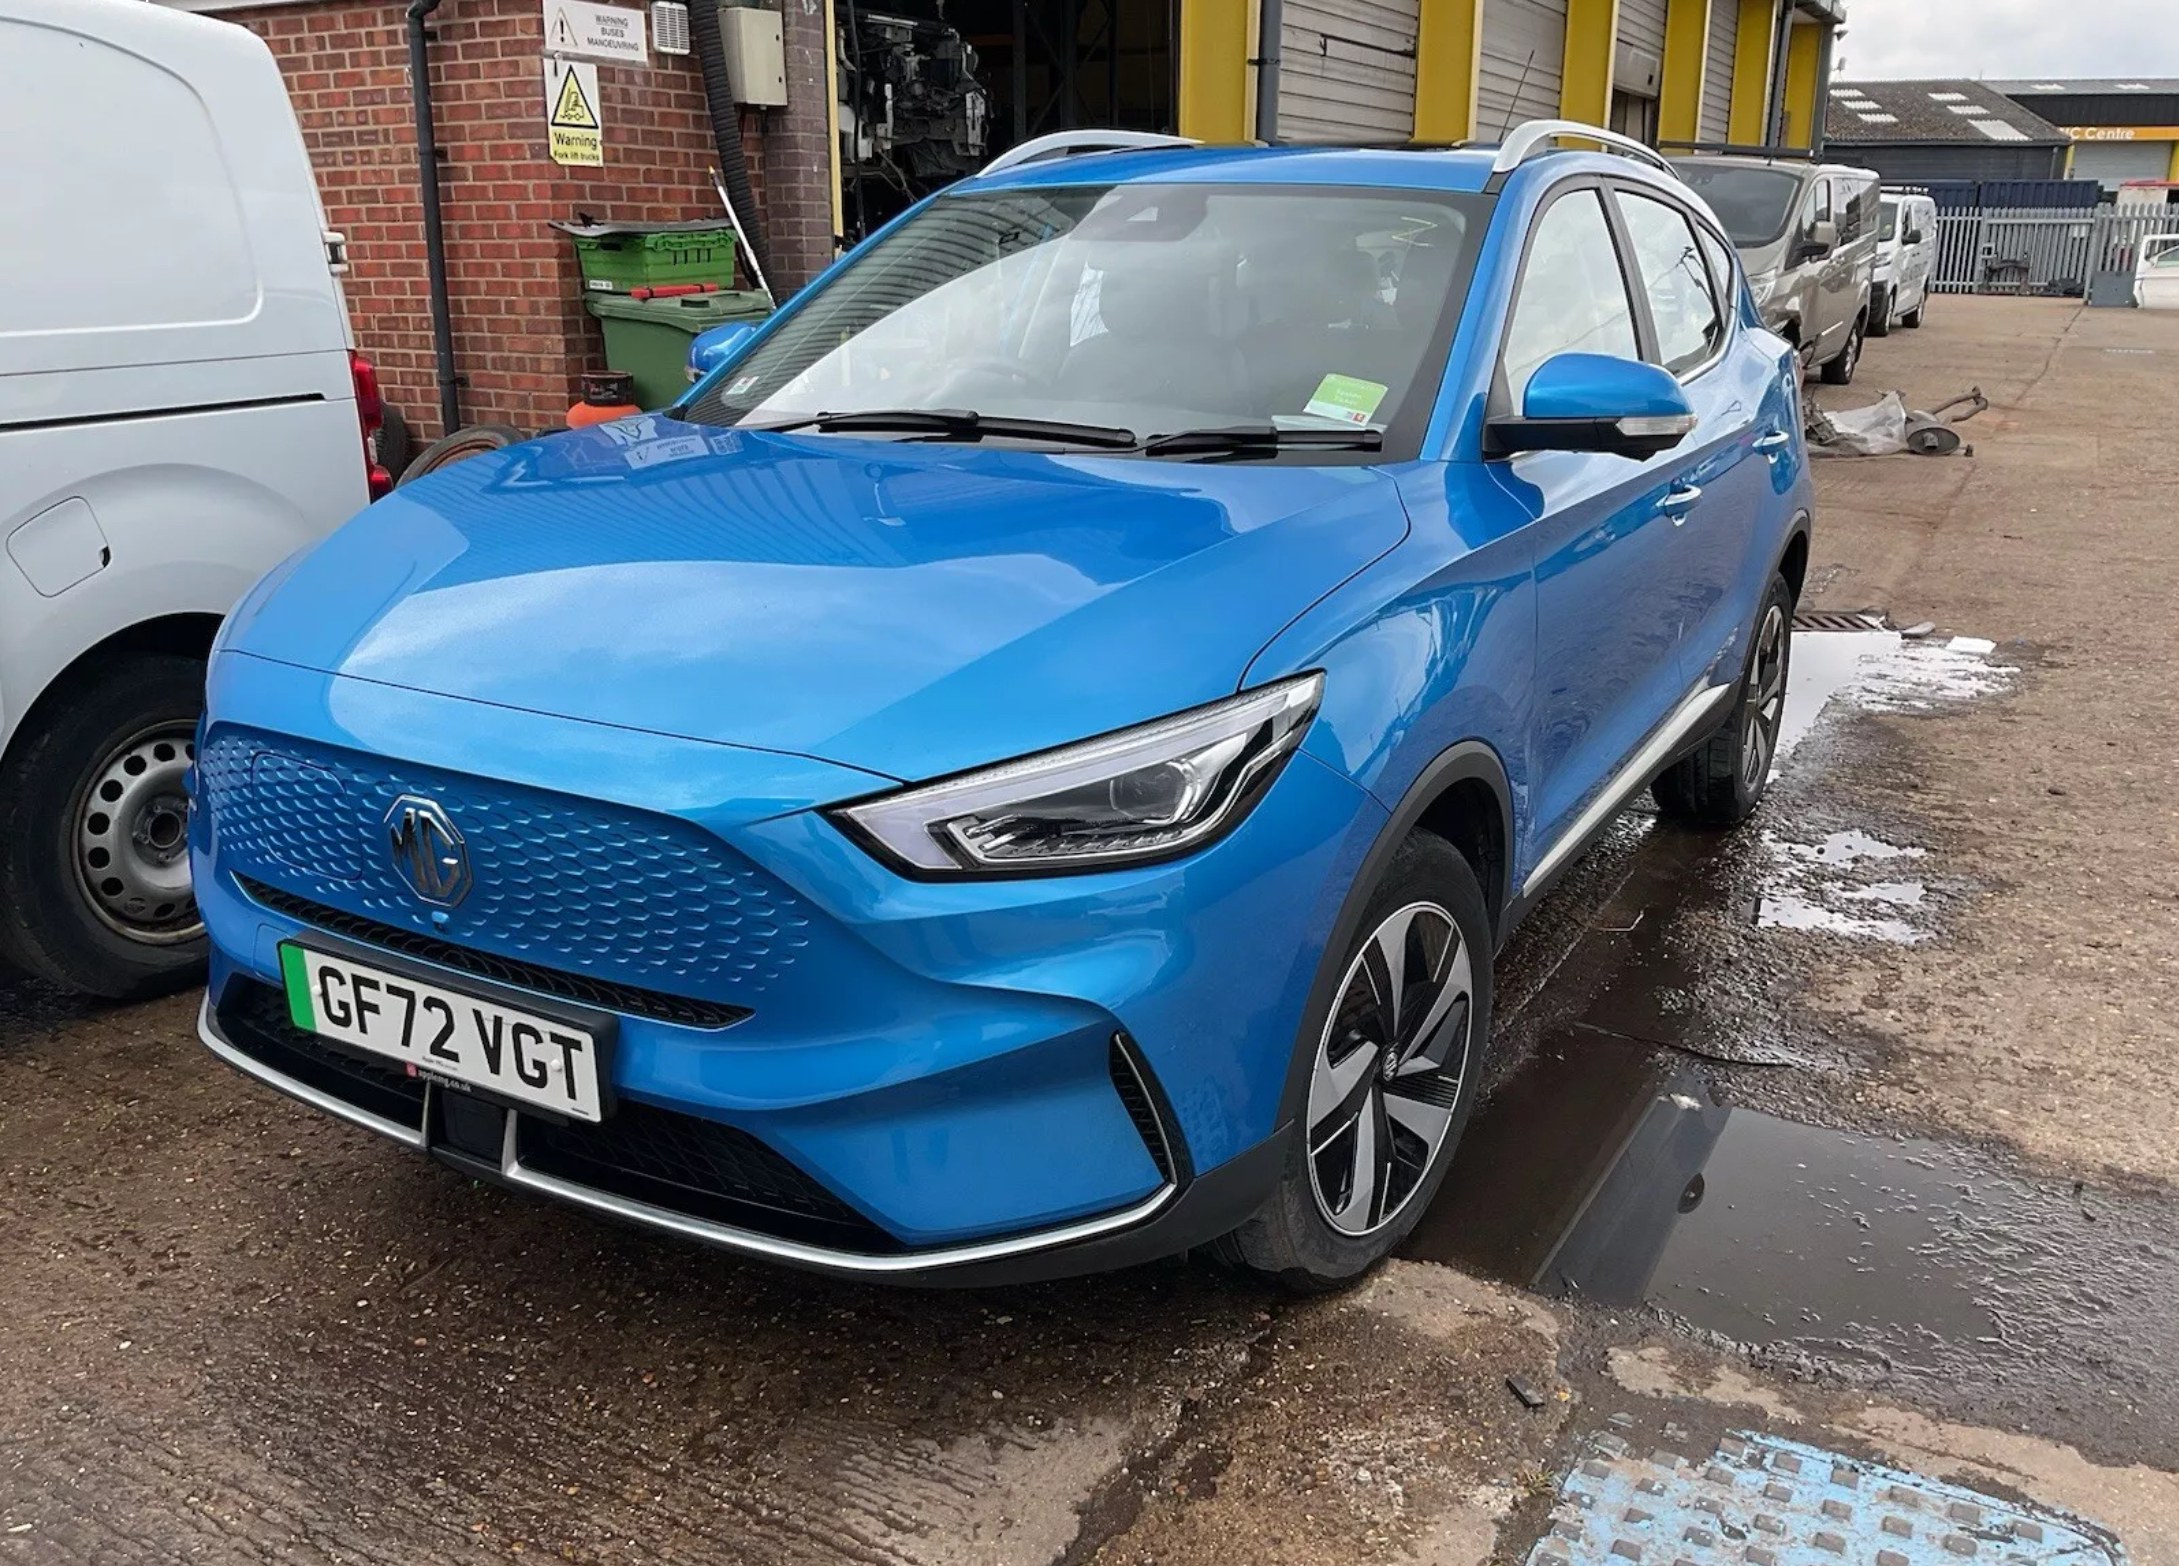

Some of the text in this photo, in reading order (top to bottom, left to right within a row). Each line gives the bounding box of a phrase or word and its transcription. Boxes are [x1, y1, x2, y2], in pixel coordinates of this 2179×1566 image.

[595, 15, 628, 27] WARNING
[600, 27, 625, 38] BUSES
[587, 37, 639, 51] MANOEUVRING
[2085, 126, 2136, 140] Centre
[554, 132, 598, 151] Warning
[389, 806, 460, 899] MG
[318, 965, 584, 1102] GF72 VGT
